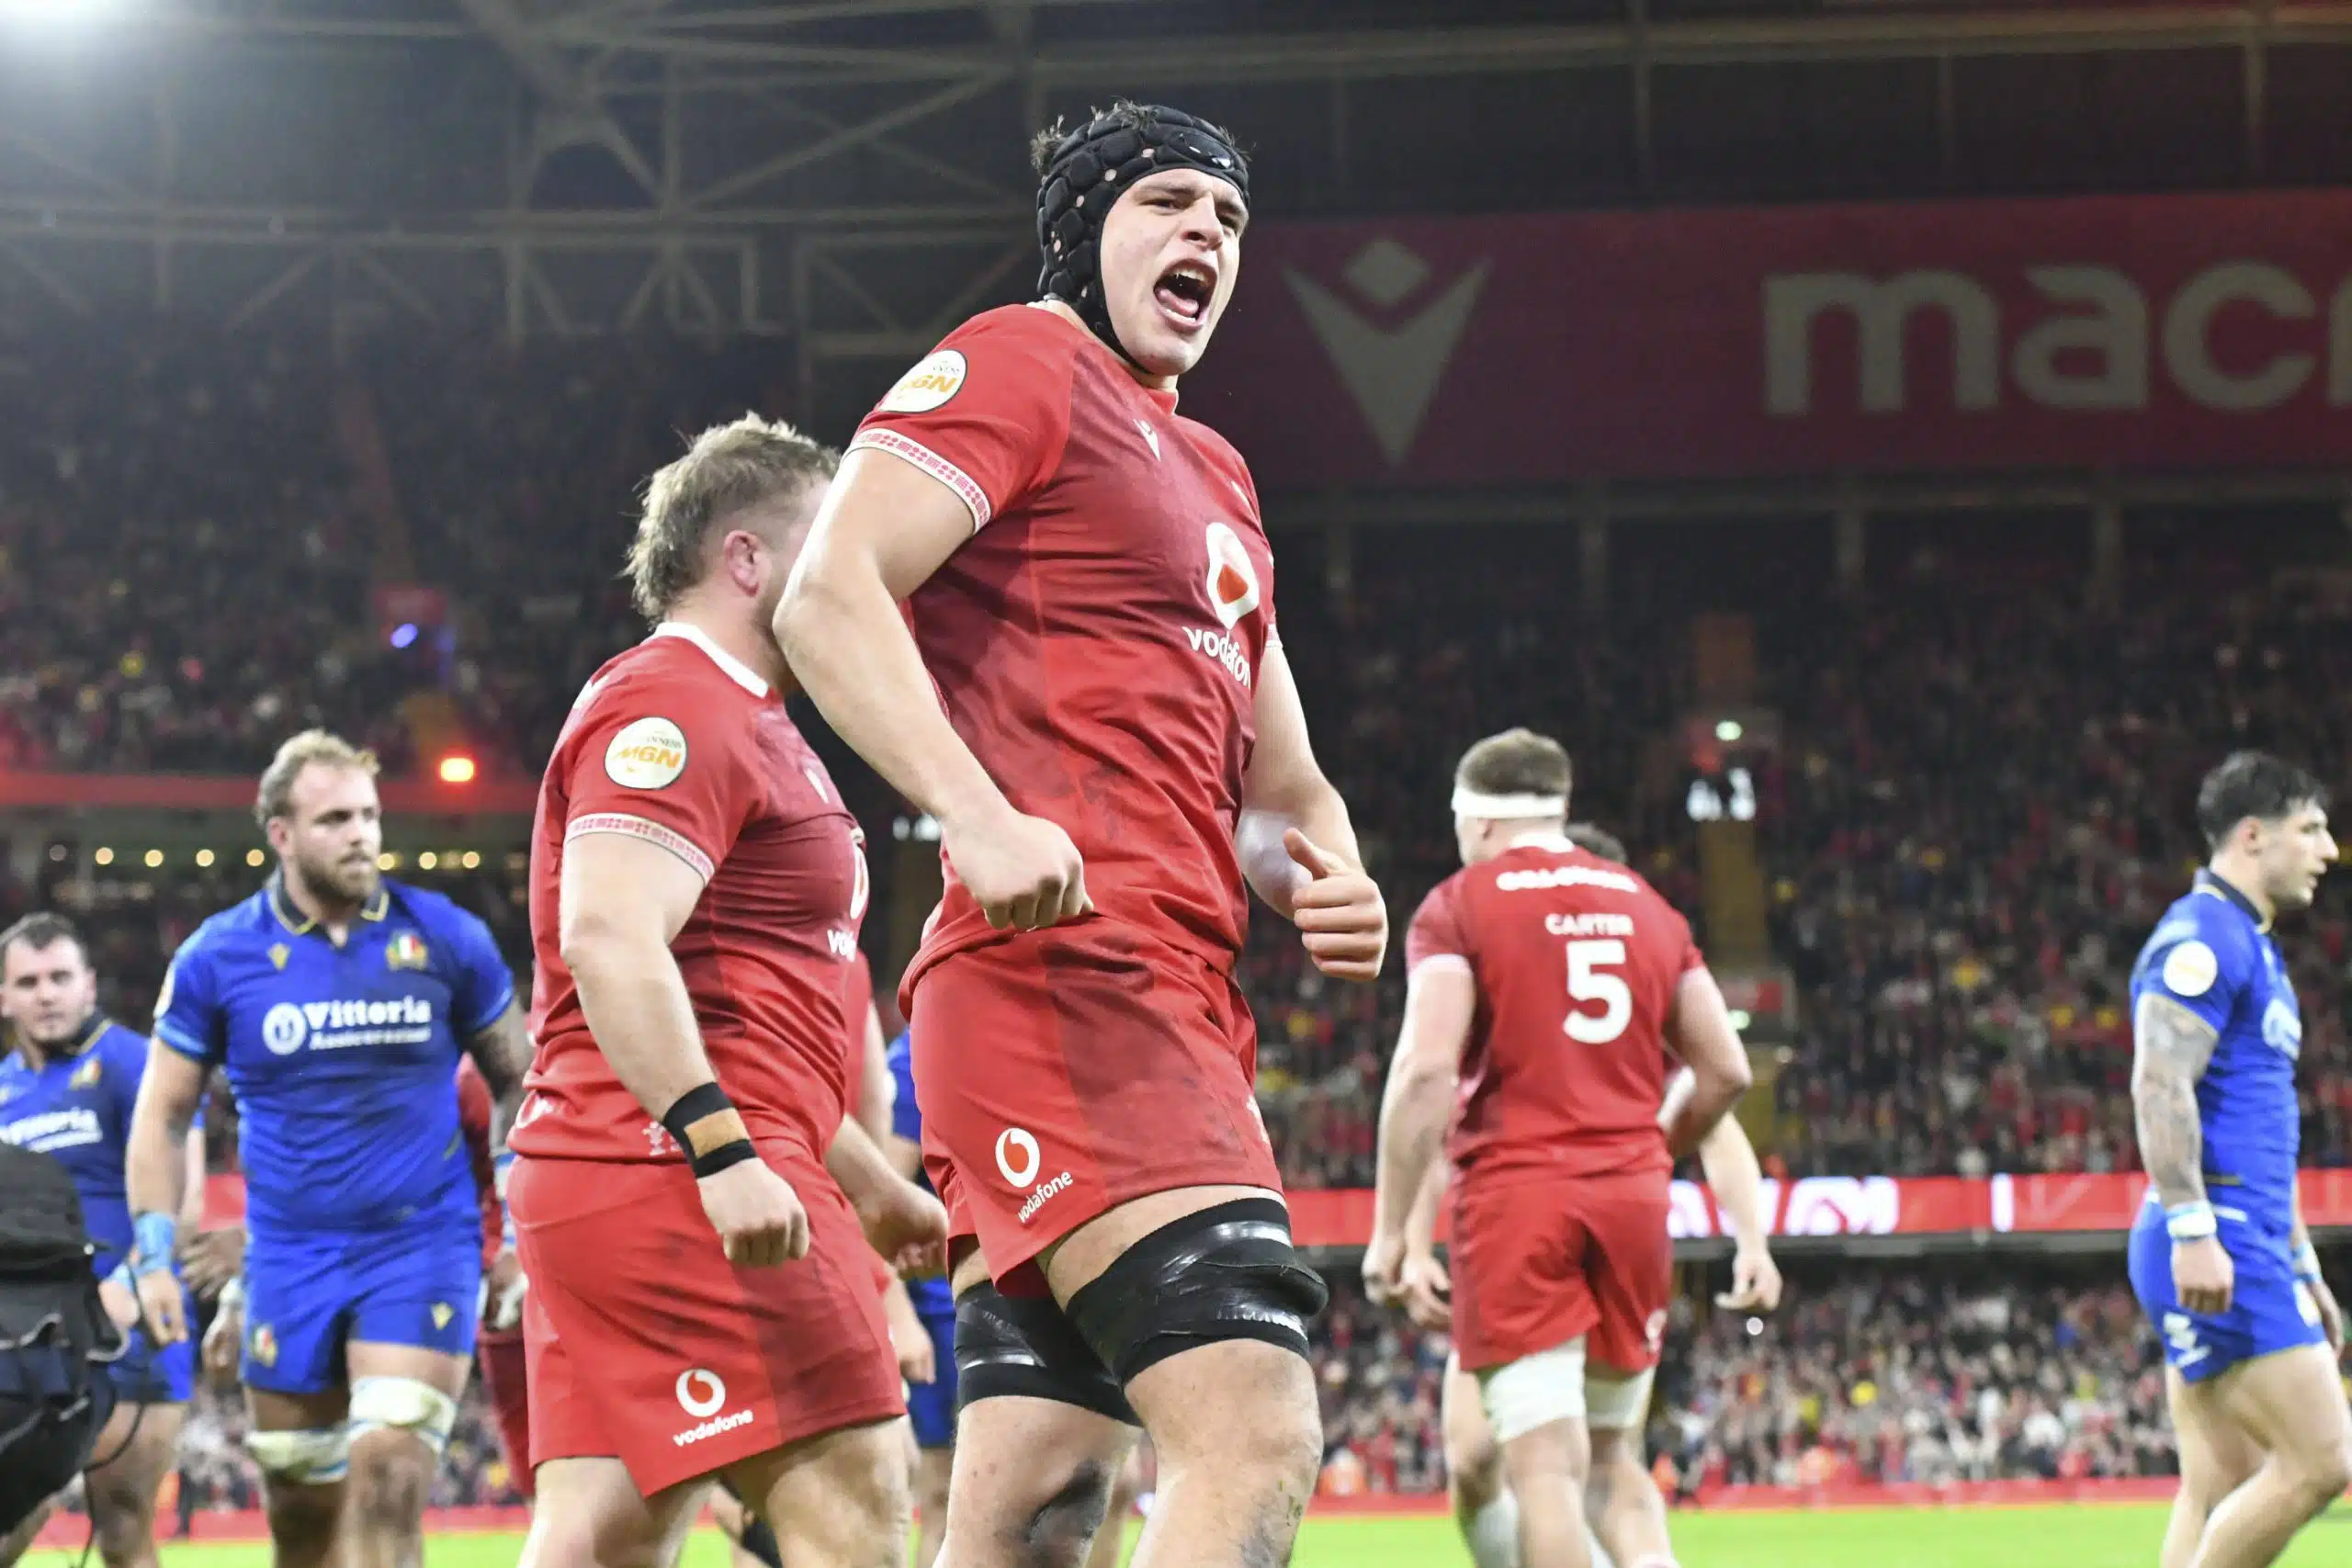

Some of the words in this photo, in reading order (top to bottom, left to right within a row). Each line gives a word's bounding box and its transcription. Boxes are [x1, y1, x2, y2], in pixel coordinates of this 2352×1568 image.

[1762, 261, 2352, 416] mac
[1182, 626, 1251, 691] vodafon
[1544, 913, 1634, 936] CARTER
[303, 995, 431, 1030] Vittoria
[1563, 939, 1633, 1043] 5
[1017, 1171, 1073, 1224] vodafone
[673, 1409, 754, 1447] vodafone
